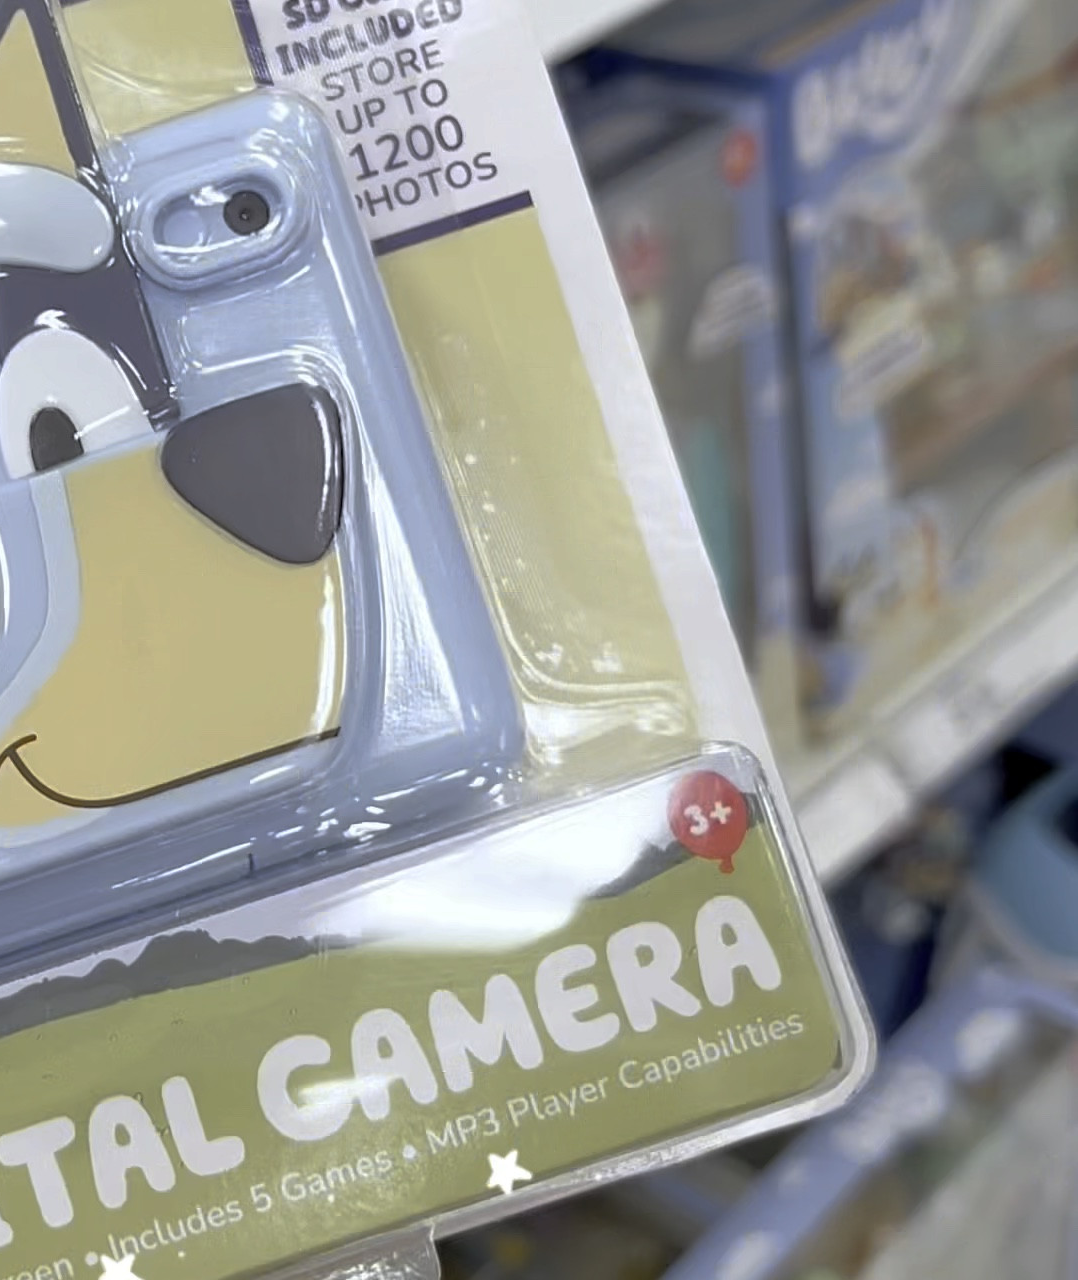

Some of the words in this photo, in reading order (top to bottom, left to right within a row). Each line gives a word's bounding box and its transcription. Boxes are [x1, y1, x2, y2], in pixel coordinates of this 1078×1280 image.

[322, 39, 444, 101] STORE
[336, 97, 385, 135] UP
[393, 78, 448, 115] TO
[349, 114, 463, 181] 1200
[354, 152, 497, 217] HOTOS
[684, 799, 732, 837] 3+
[257, 895, 782, 1141] CAMERA
[108, 1198, 244, 1257] Includes
[251, 1183, 273, 1214] 5
[281, 1146, 393, 1201] Games
[426, 1108, 500, 1155] MP3
[507, 1073, 610, 1129] Player
[618, 1013, 805, 1091] Capabilities
